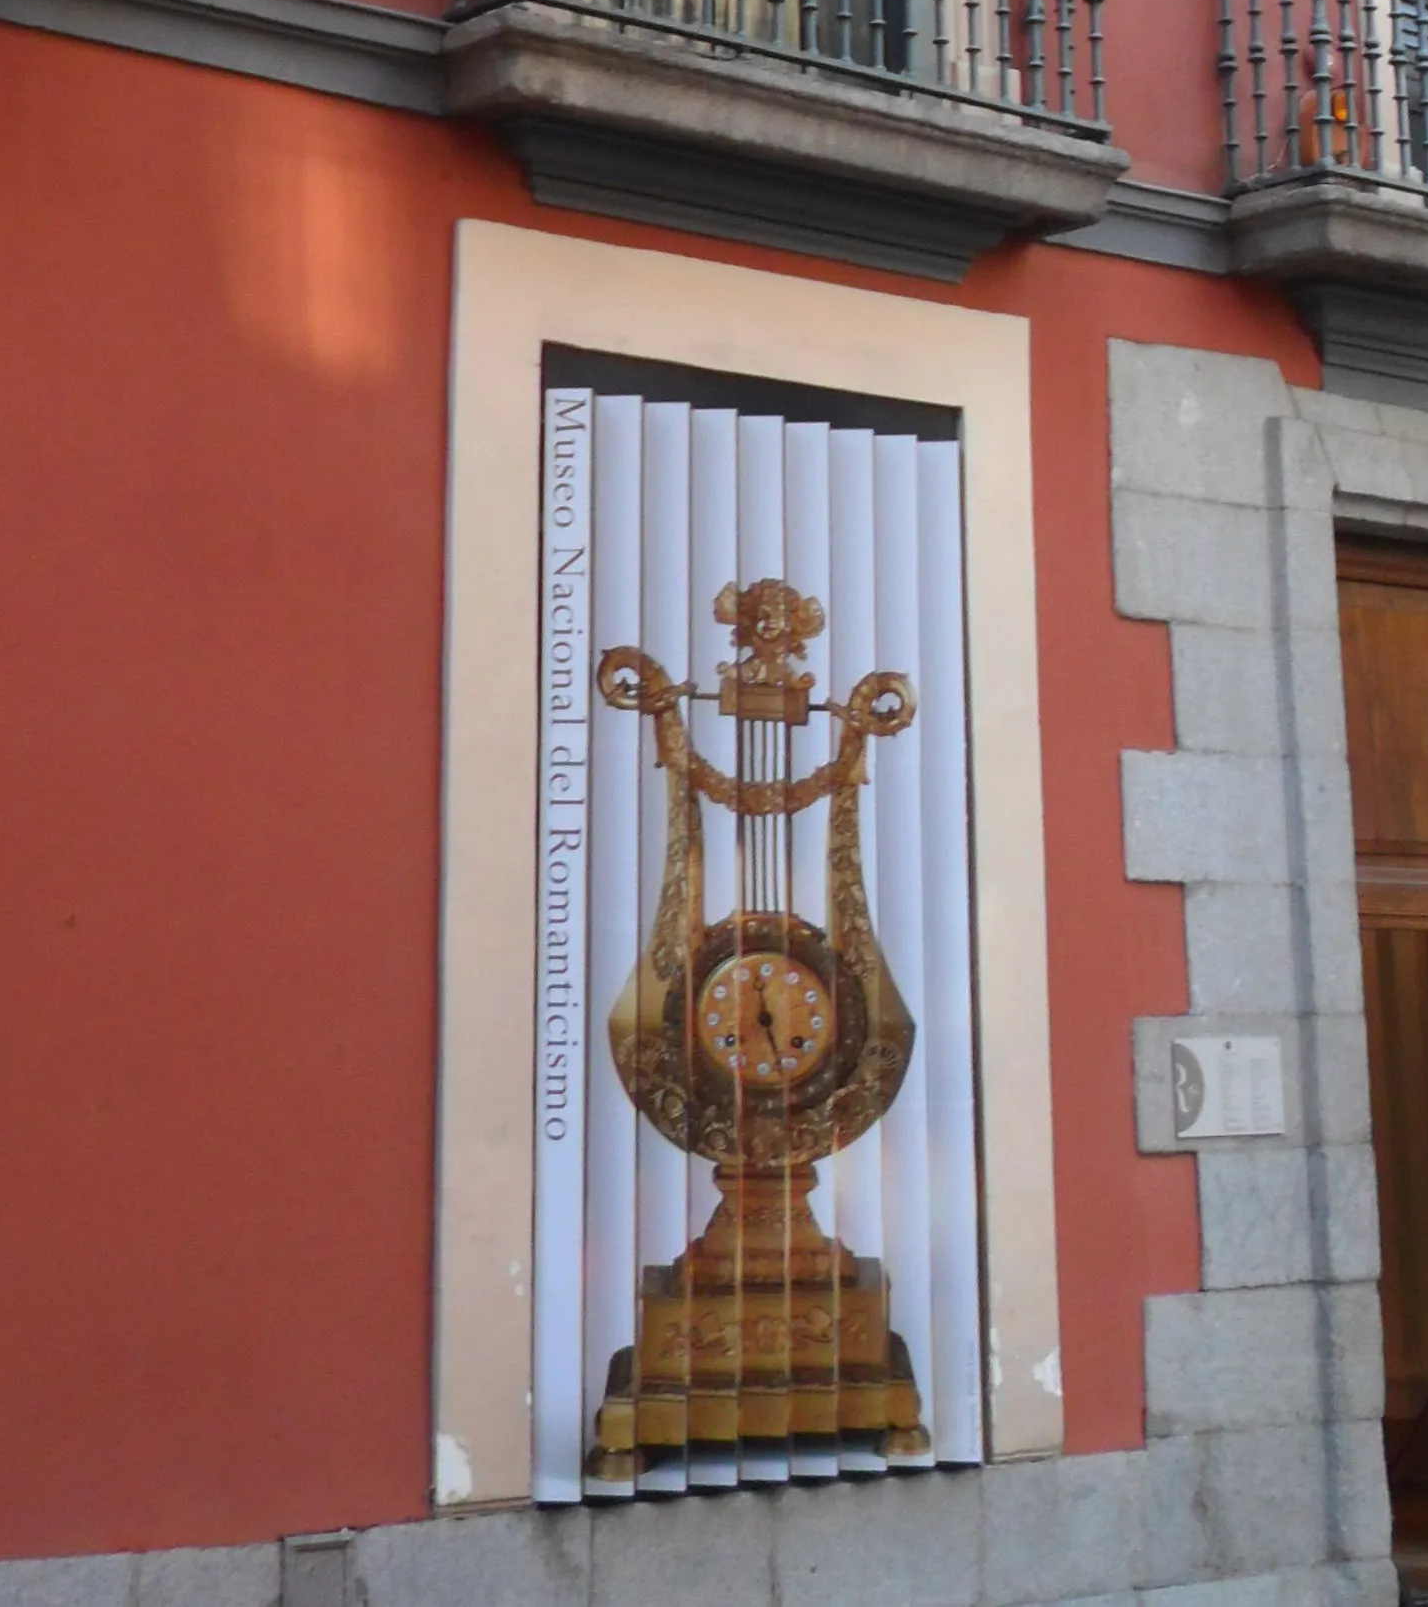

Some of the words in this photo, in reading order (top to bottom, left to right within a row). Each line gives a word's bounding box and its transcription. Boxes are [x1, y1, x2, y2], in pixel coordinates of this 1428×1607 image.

[552, 397, 587, 529] Museo
[550, 546, 586, 725] Nacional
[548, 745, 586, 806] del
[543, 827, 583, 1143] Romanticismo
